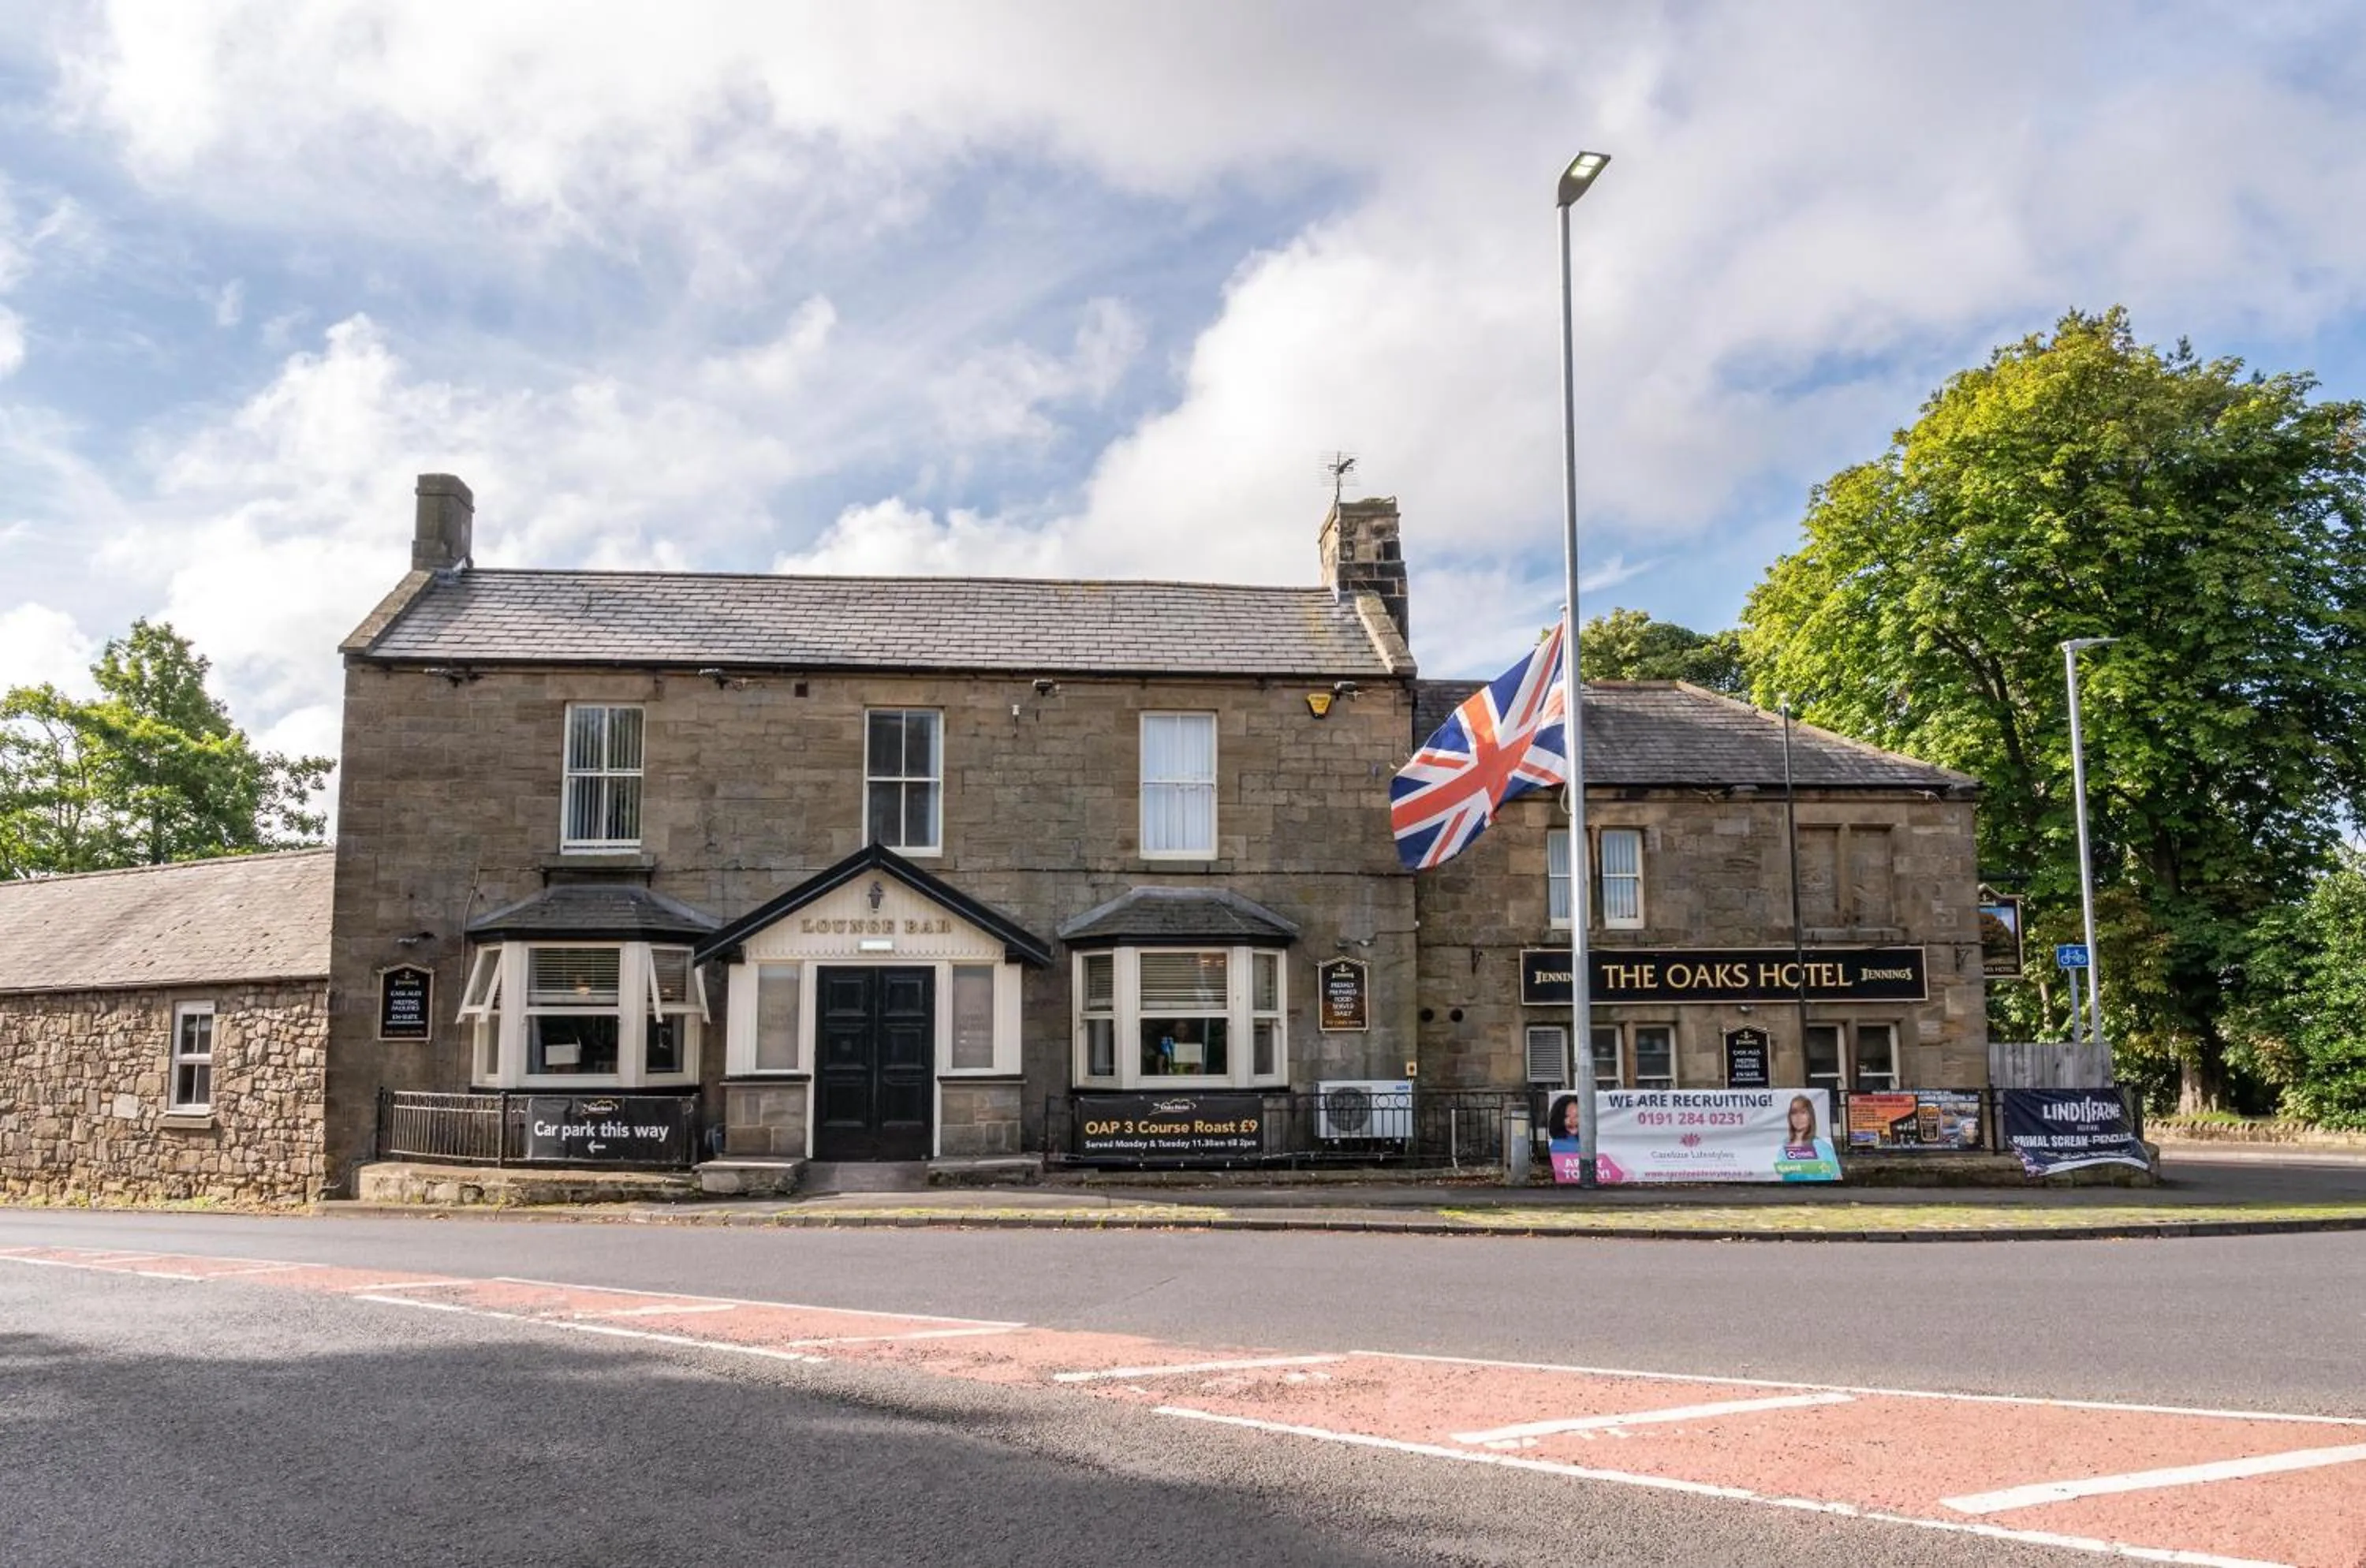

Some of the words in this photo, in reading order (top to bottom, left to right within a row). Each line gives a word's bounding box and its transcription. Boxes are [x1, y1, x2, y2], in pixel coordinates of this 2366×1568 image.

[801, 919, 895, 934] LOUNGE
[905, 919, 951, 934] BAR
[1535, 971, 1573, 984] JENNIN
[1603, 965, 1658, 988] THE
[1666, 963, 1749, 989] OAKS
[1758, 963, 1853, 989] HOTEL
[1861, 968, 1913, 981] JENNINGS
[1609, 1095, 1633, 1108] WE
[1637, 1095, 1667, 1107] ARE
[1673, 1095, 1773, 1107] RECRUITING!
[1638, 1112, 1673, 1126] 0191
[1678, 1112, 1704, 1125] 284
[1710, 1112, 1744, 1125] 0231
[534, 1121, 558, 1137] Car
[562, 1121, 595, 1141] park
[600, 1121, 629, 1137] this
[634, 1126, 669, 1142] way
[1085, 1121, 1120, 1135] OAP
[1125, 1121, 1133, 1134] 3
[1138, 1121, 1189, 1134] Course
[1195, 1119, 1235, 1133] Roast
[1240, 1119, 1258, 1133] £9
[1085, 1141, 1113, 1149] Served
[1115, 1140, 1147, 1149] Monday
[1149, 1140, 1156, 1148] &
[1158, 1140, 1189, 1149] Tuesday
[2013, 1135, 2050, 1147] PRIMAL
[2051, 1135, 2088, 1147] SCREAM
[1565, 1158, 1603, 1167] APY
[1564, 1169, 1610, 1179] TOY!
